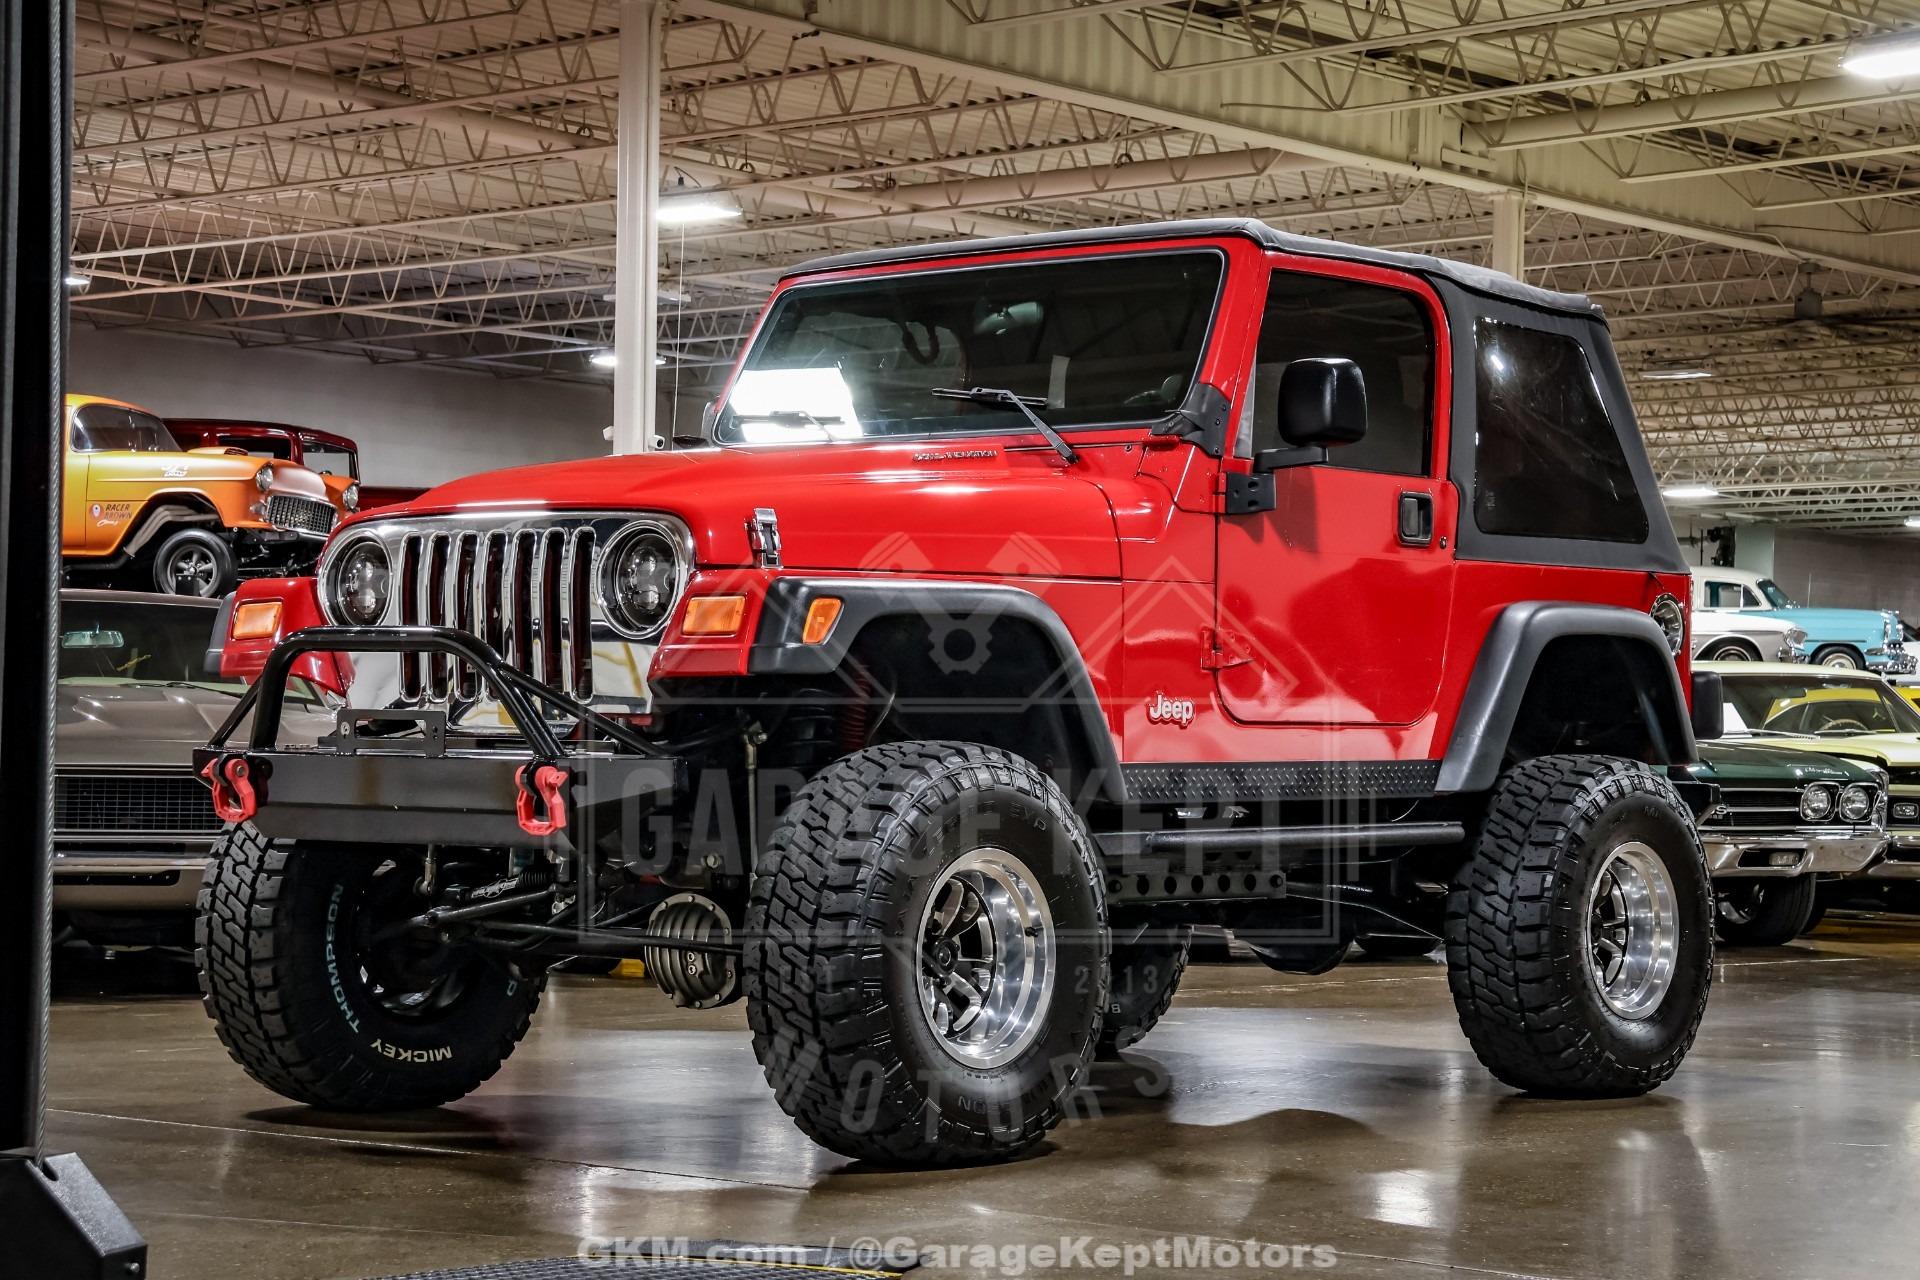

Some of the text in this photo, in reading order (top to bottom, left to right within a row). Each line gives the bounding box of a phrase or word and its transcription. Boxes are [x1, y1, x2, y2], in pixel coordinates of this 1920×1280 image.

[105, 503, 131, 512] RACER
[1149, 693, 1194, 725] Jeep
[325, 883, 454, 1064] MICKEY THOMPSON
